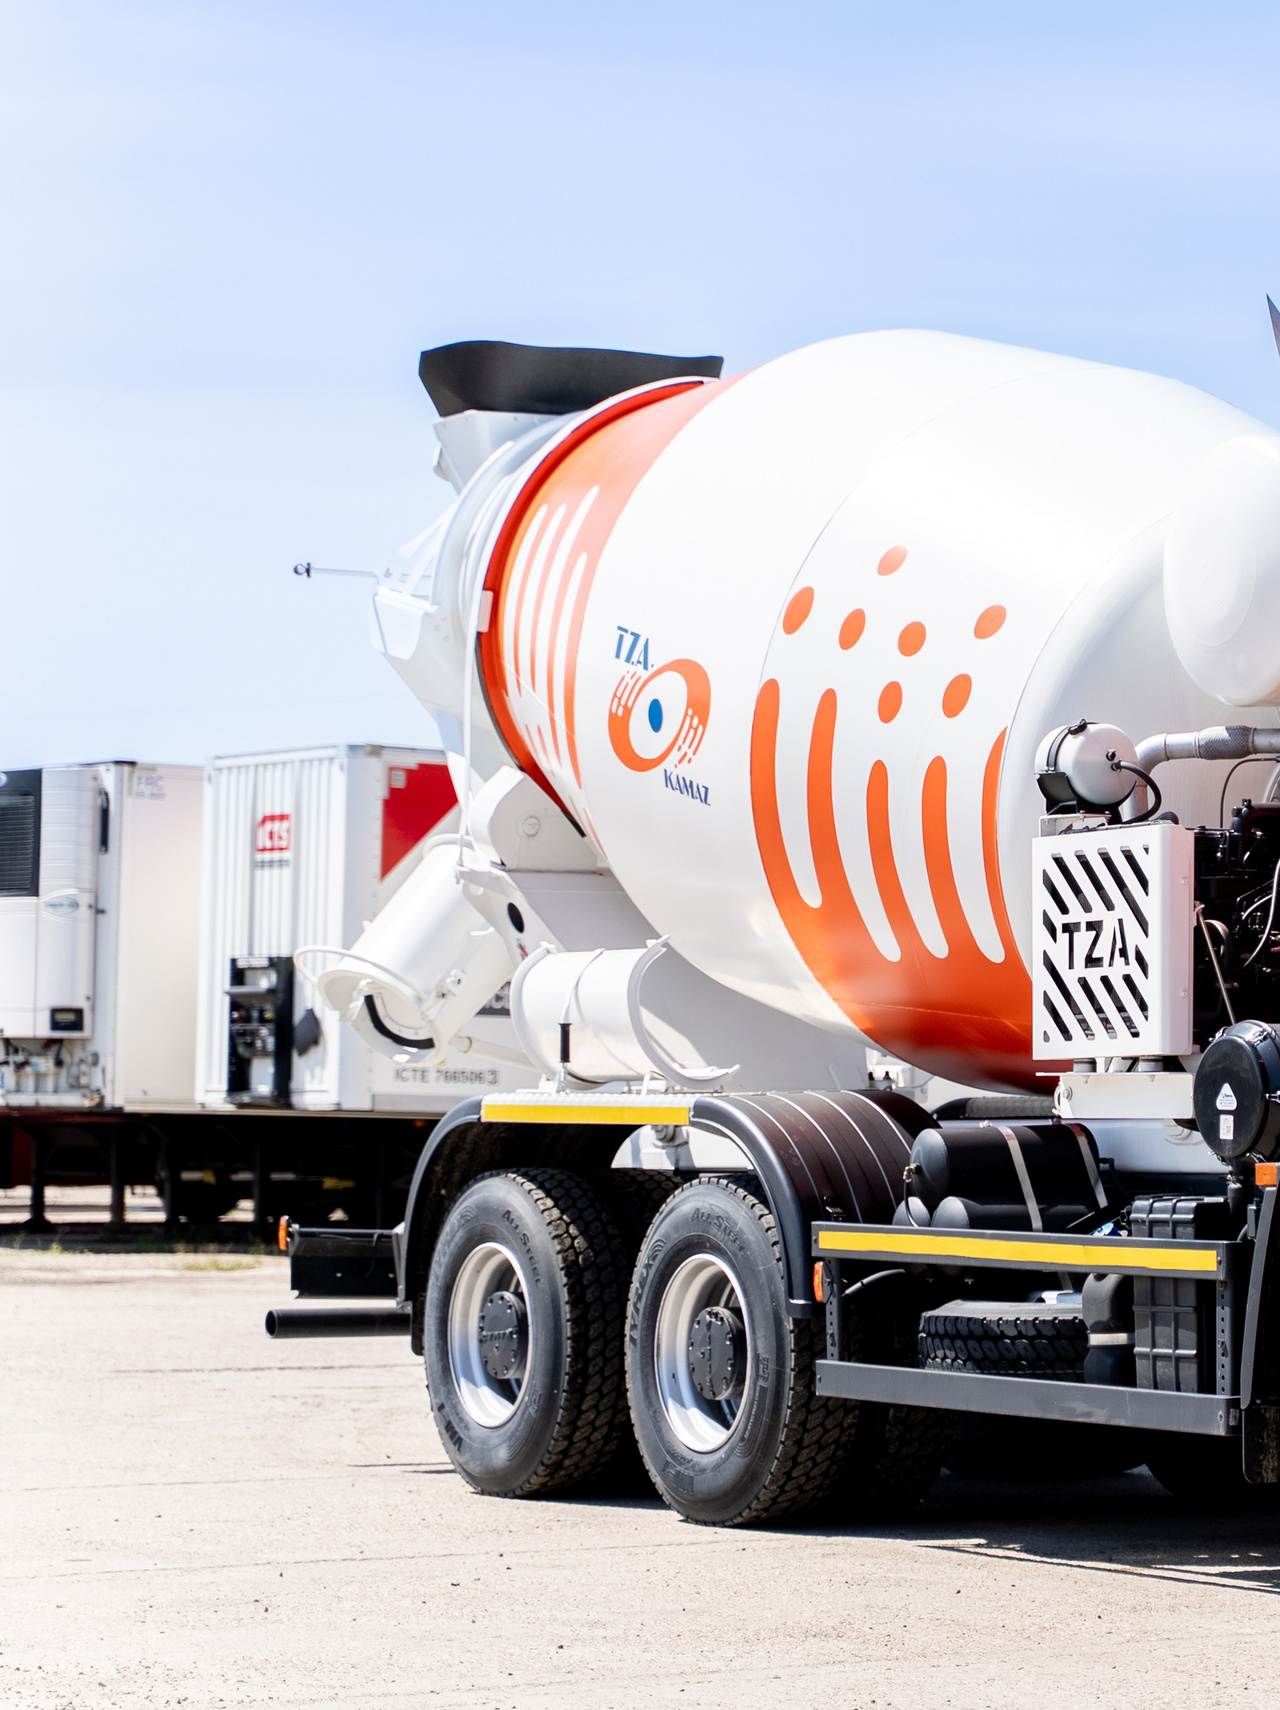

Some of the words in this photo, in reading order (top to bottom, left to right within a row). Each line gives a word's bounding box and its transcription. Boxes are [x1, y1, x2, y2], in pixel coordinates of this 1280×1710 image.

[664, 768, 711, 806] KAMAZ
[1062, 918, 1130, 970] TZA
[393, 1068, 430, 1083] ICTE
